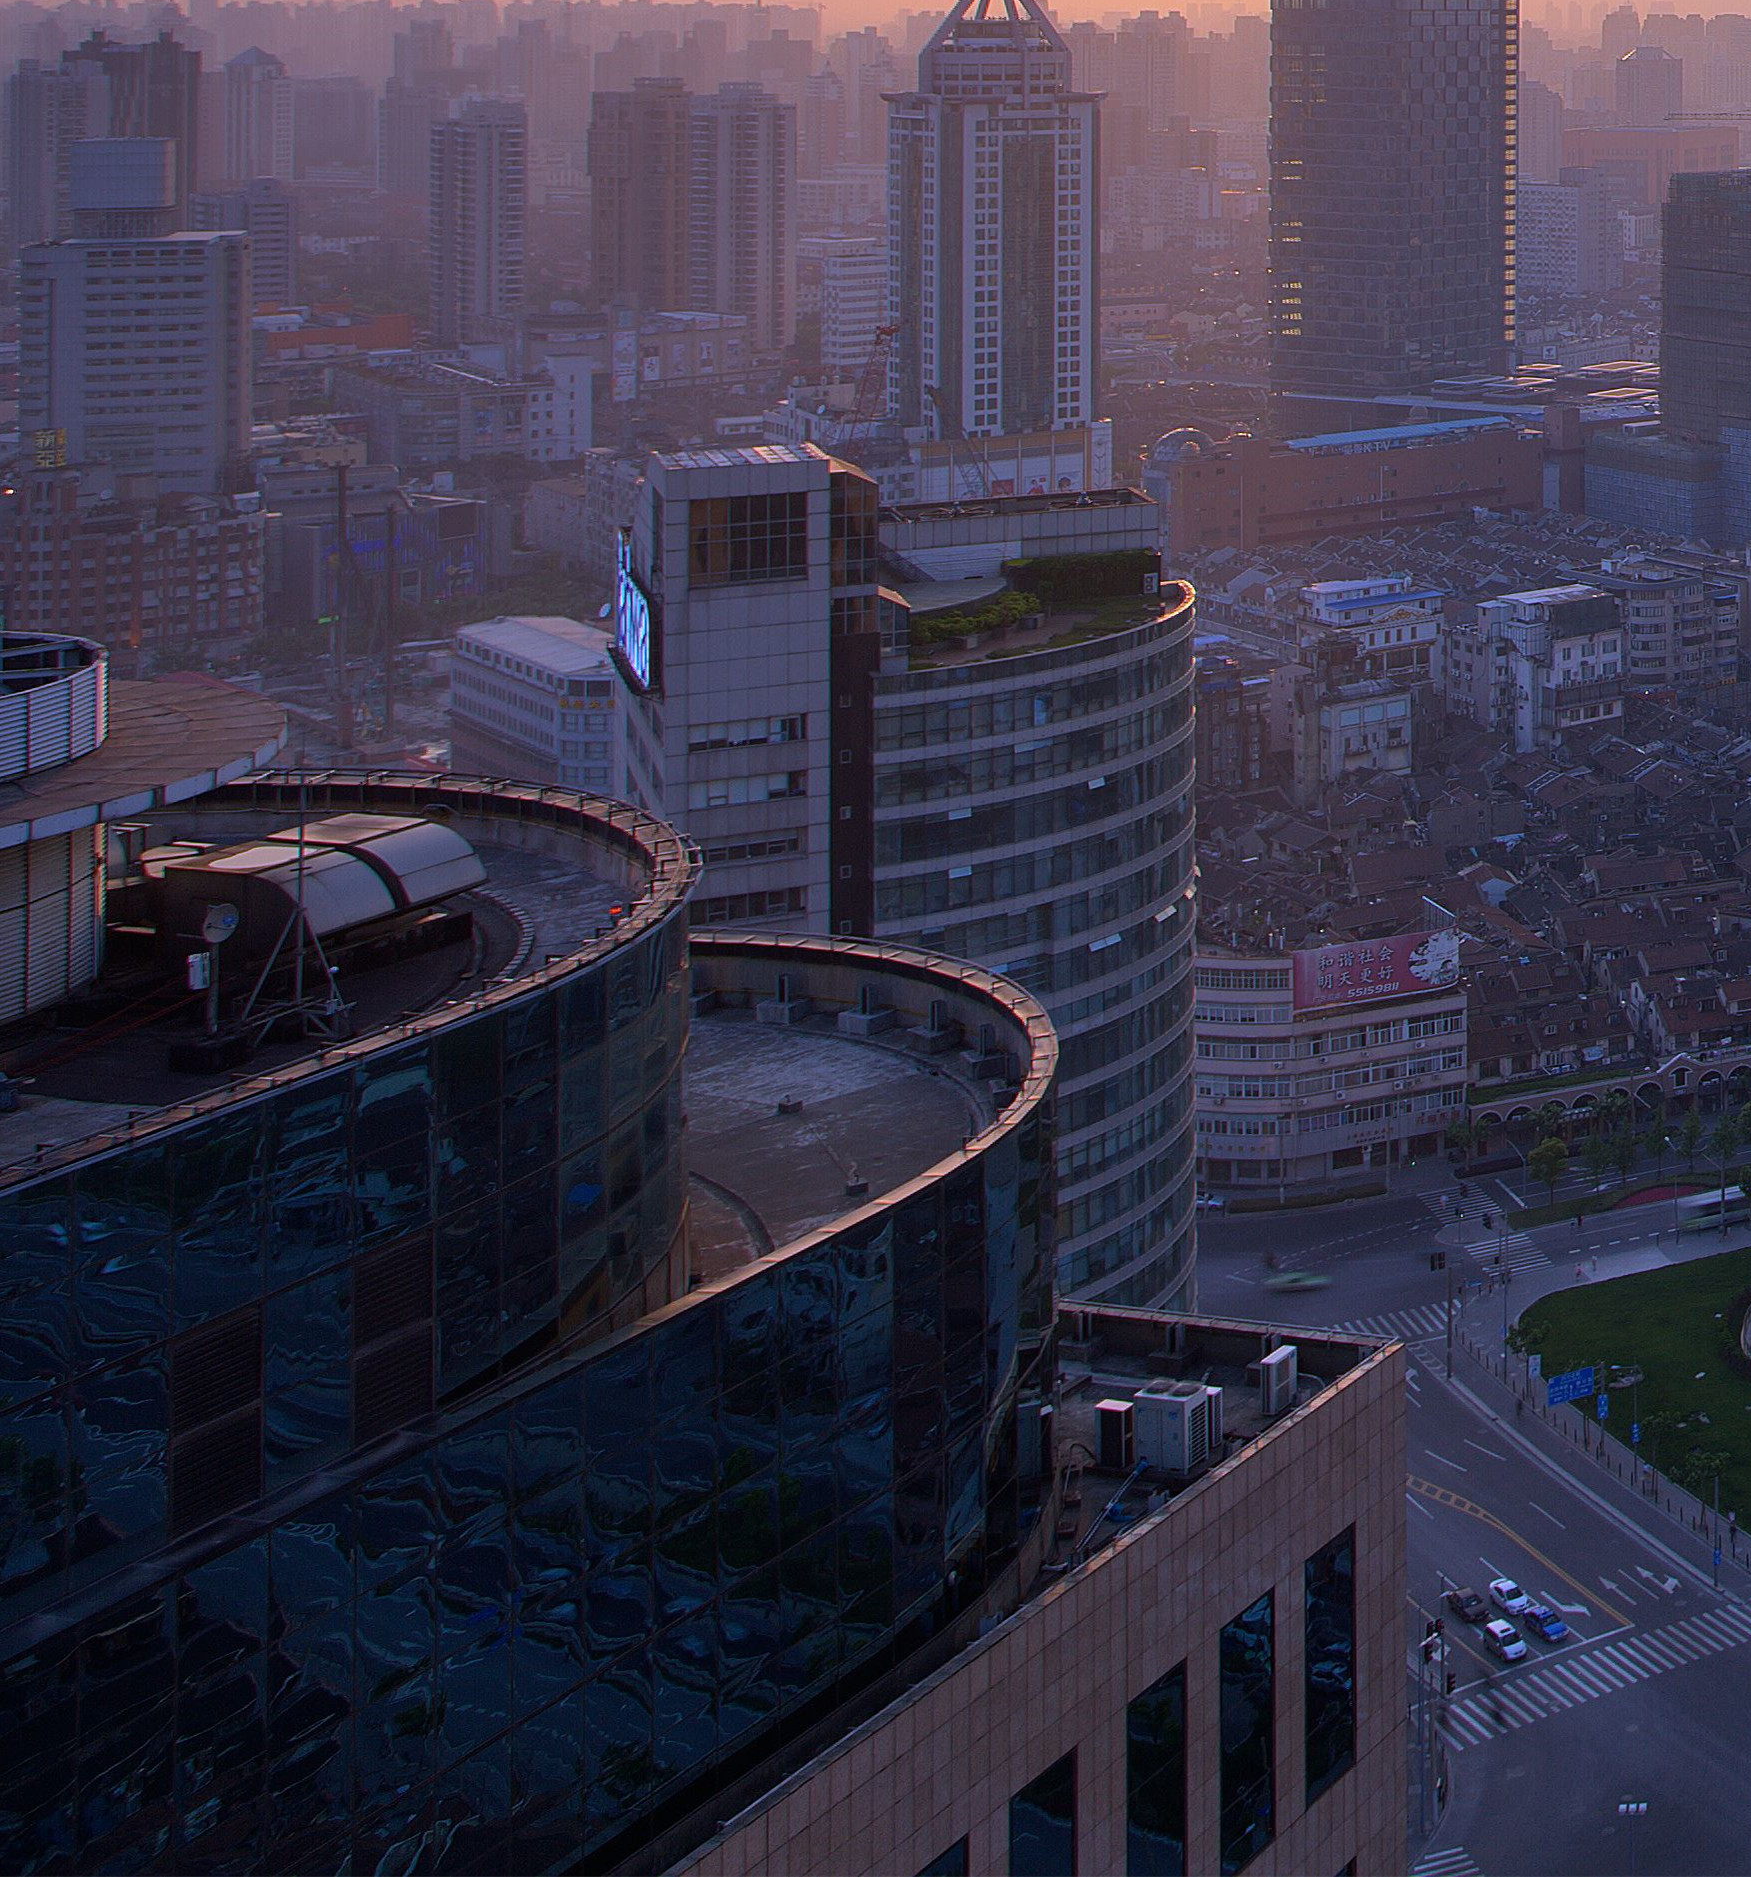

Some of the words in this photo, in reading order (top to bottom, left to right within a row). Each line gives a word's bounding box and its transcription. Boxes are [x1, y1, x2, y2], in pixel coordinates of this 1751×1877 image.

[1318, 945, 1395, 971] 和谐社会
[1317, 965, 1395, 990] 明天更好
